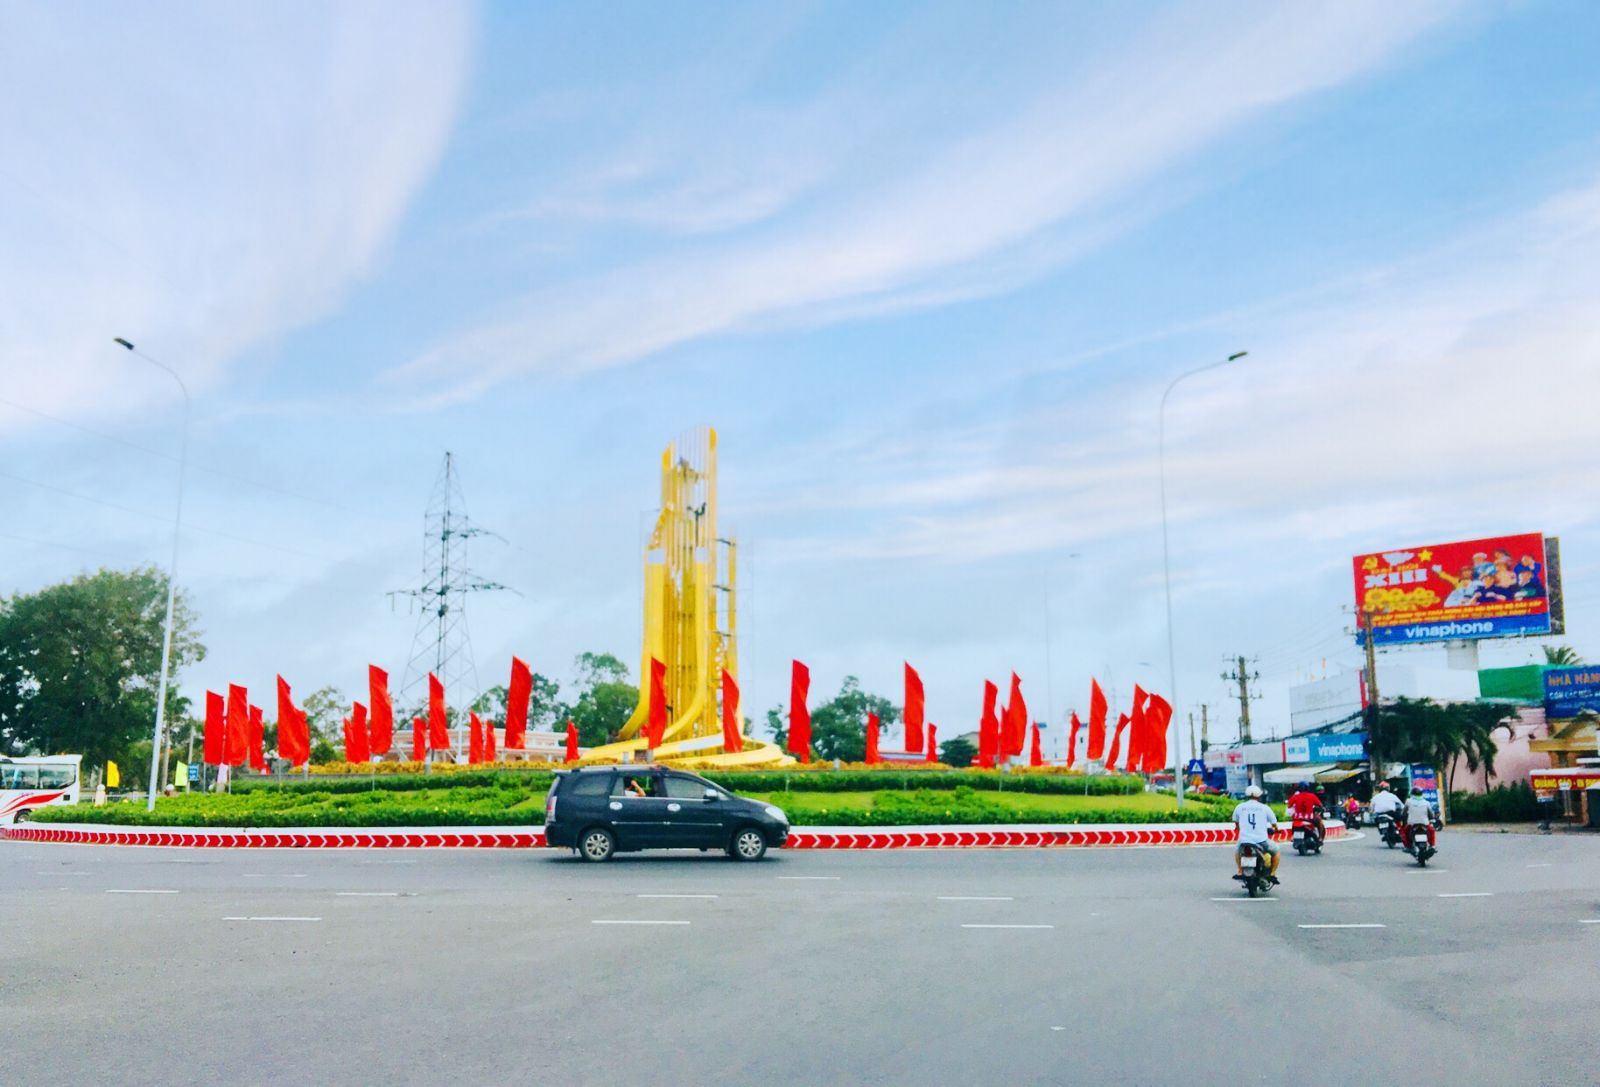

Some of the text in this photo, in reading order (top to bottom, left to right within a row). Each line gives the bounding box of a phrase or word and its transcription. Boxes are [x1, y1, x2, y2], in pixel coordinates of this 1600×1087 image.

[1405, 621, 1494, 638] vinaphone
[1318, 742, 1364, 757] vinaphone
[1248, 813, 1256, 830] 4
